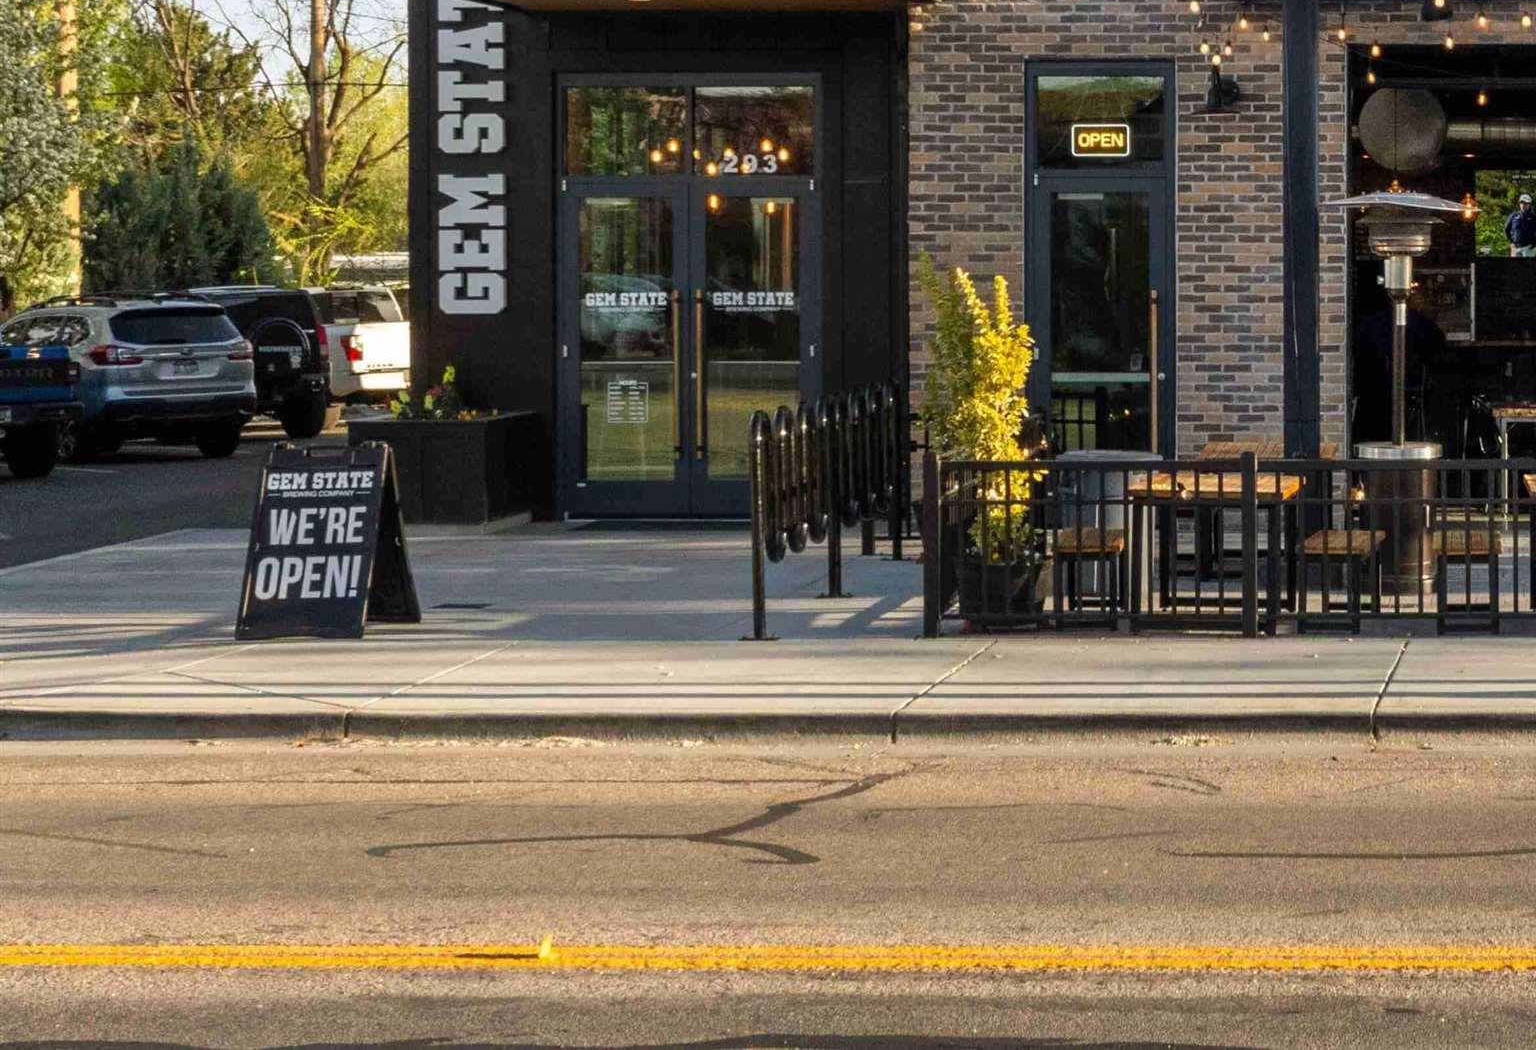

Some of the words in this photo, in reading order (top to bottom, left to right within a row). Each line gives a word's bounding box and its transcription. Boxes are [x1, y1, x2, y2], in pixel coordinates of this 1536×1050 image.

[1077, 132, 1125, 148] OPEN
[723, 153, 778, 174] 293
[437, 173, 507, 315] GEM
[585, 291, 617, 307] GEM
[619, 291, 668, 307] STATE
[712, 291, 744, 306] GEM
[746, 291, 795, 306] STATE
[267, 472, 309, 490] GEM
[312, 470, 375, 489] STATE
[282, 490, 317, 498] BREWING
[318, 489, 356, 497] COMPANY
[269, 506, 368, 546] WE'RE
[254, 555, 362, 600] OPEN!
